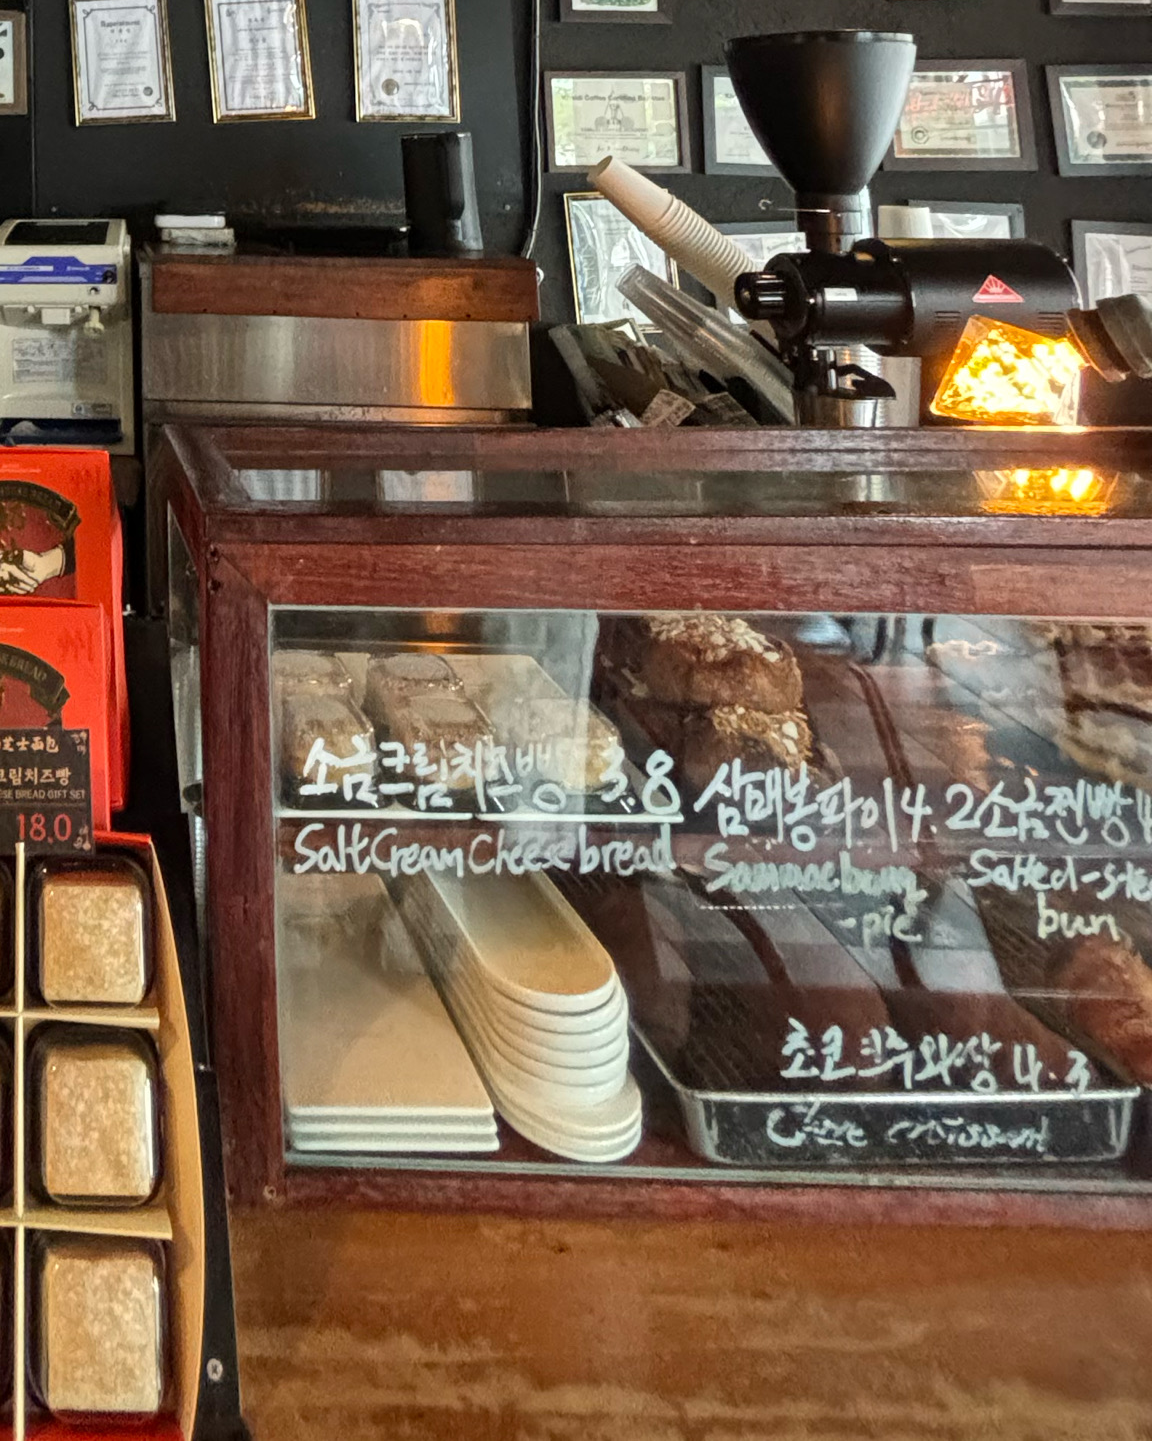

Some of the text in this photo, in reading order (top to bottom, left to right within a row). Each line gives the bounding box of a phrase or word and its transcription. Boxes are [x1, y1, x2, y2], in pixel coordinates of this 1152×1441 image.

[15, 789, 46, 800] BREAD
[47, 789, 67, 800] GIFT
[69, 789, 86, 800] SET
[577, 822, 678, 877] bread
[966, 847, 1152, 902] Salted-ste
[1036, 891, 1121, 942] bun
